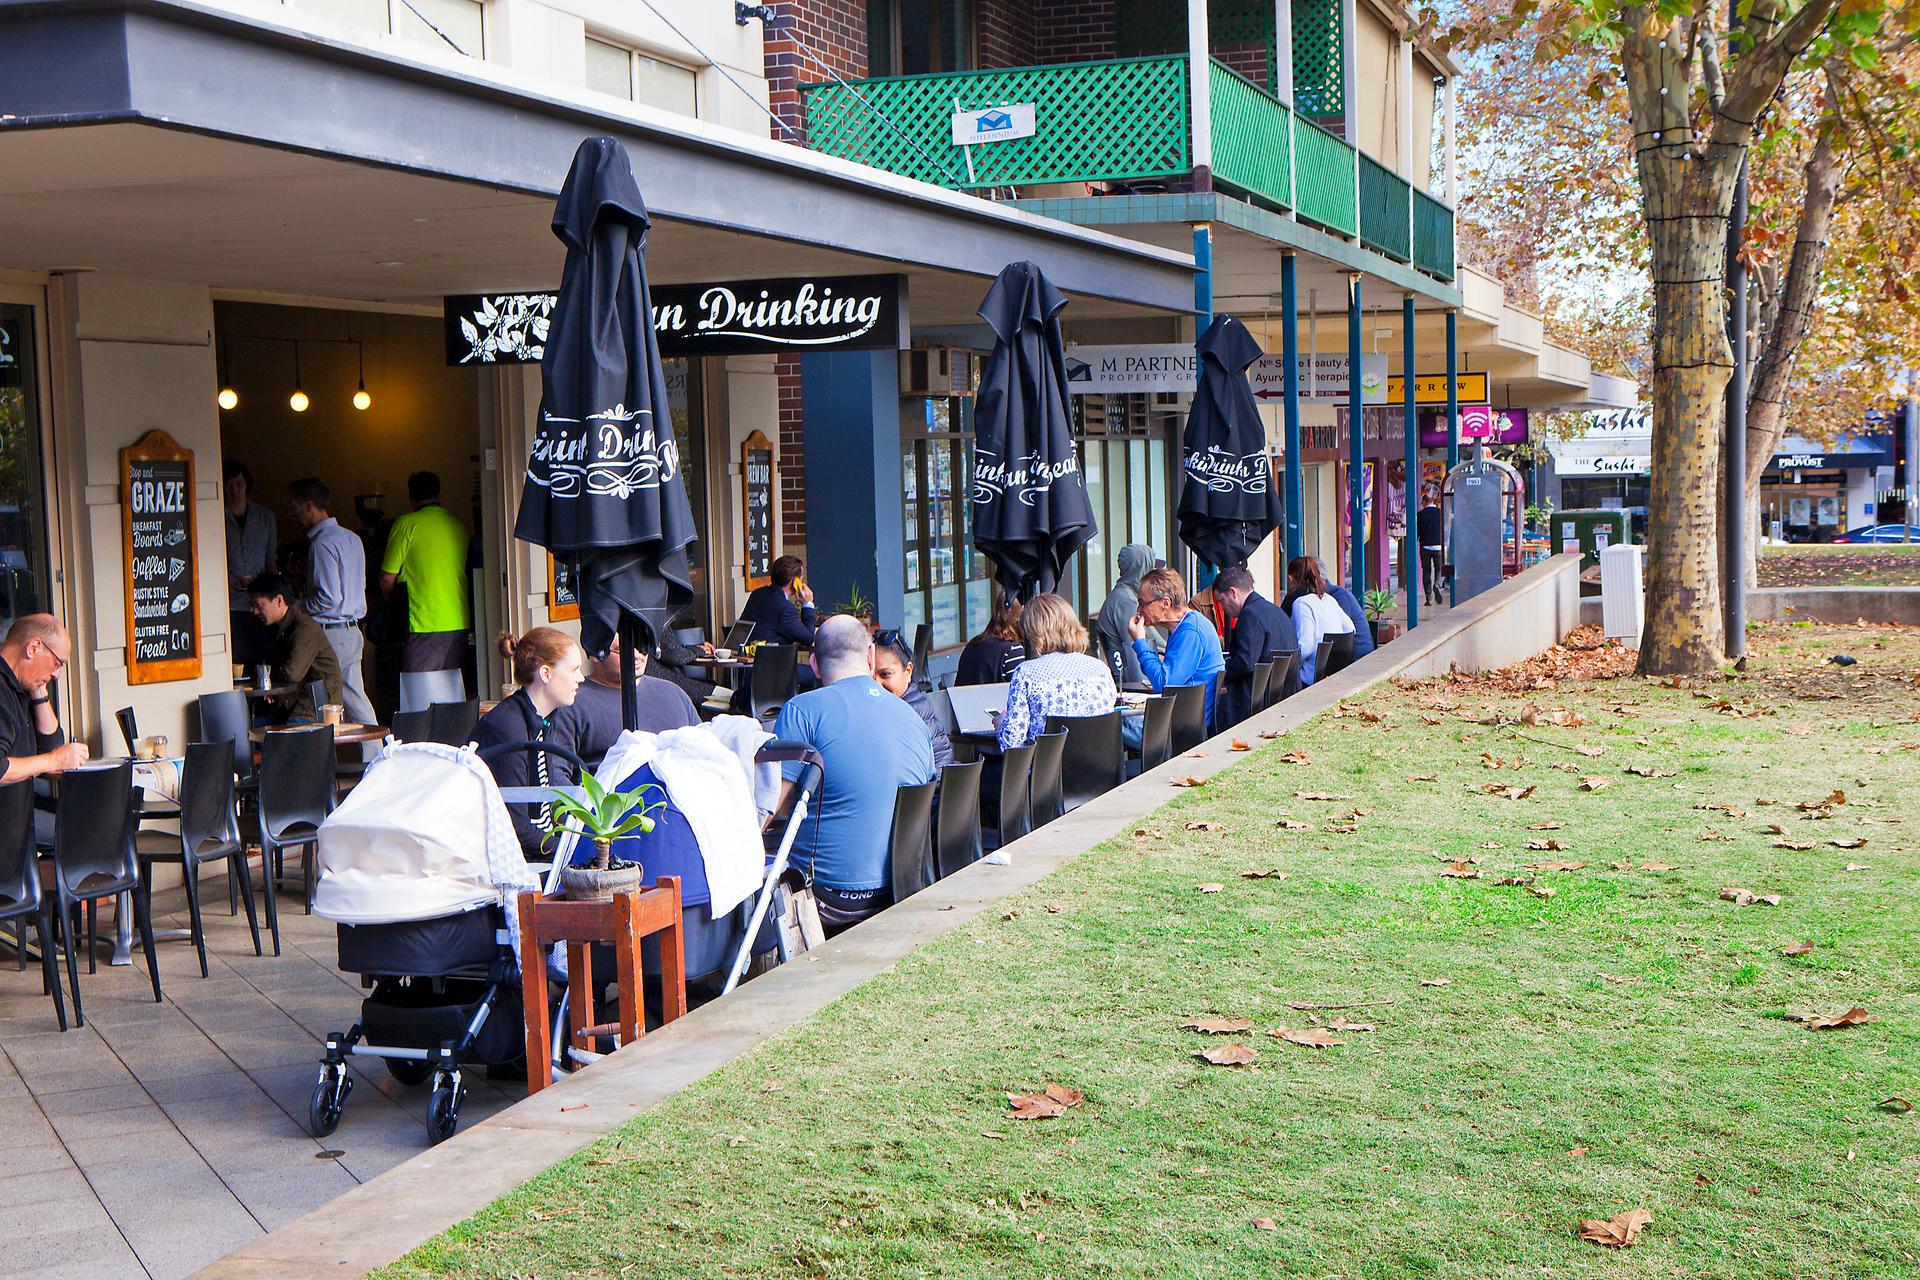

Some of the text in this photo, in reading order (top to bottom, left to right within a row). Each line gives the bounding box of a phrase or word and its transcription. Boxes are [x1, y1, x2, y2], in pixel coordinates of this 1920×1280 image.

[697, 283, 882, 332] Drinking
[1101, 356, 1197, 372] M PARTNE
[1100, 373, 1198, 382] PROPERTY GR
[1592, 408, 1646, 431] ushi
[1593, 457, 1635, 472] Sushi
[1778, 457, 1826, 468] PROVOST
[132, 481, 185, 513] GRAZE
[132, 521, 162, 531] BREAKFAST
[133, 531, 163, 548] Boards
[132, 555, 167, 581] Jaffles
[134, 586, 169, 600] RUSTIC STYLE
[134, 600, 168, 619] Sandwiches
[135, 624, 169, 637] GLUTEN FREE
[135, 639, 168, 660] Treats
[1113, 651, 1122, 667] 3
[840, 890, 878, 900] BOND
